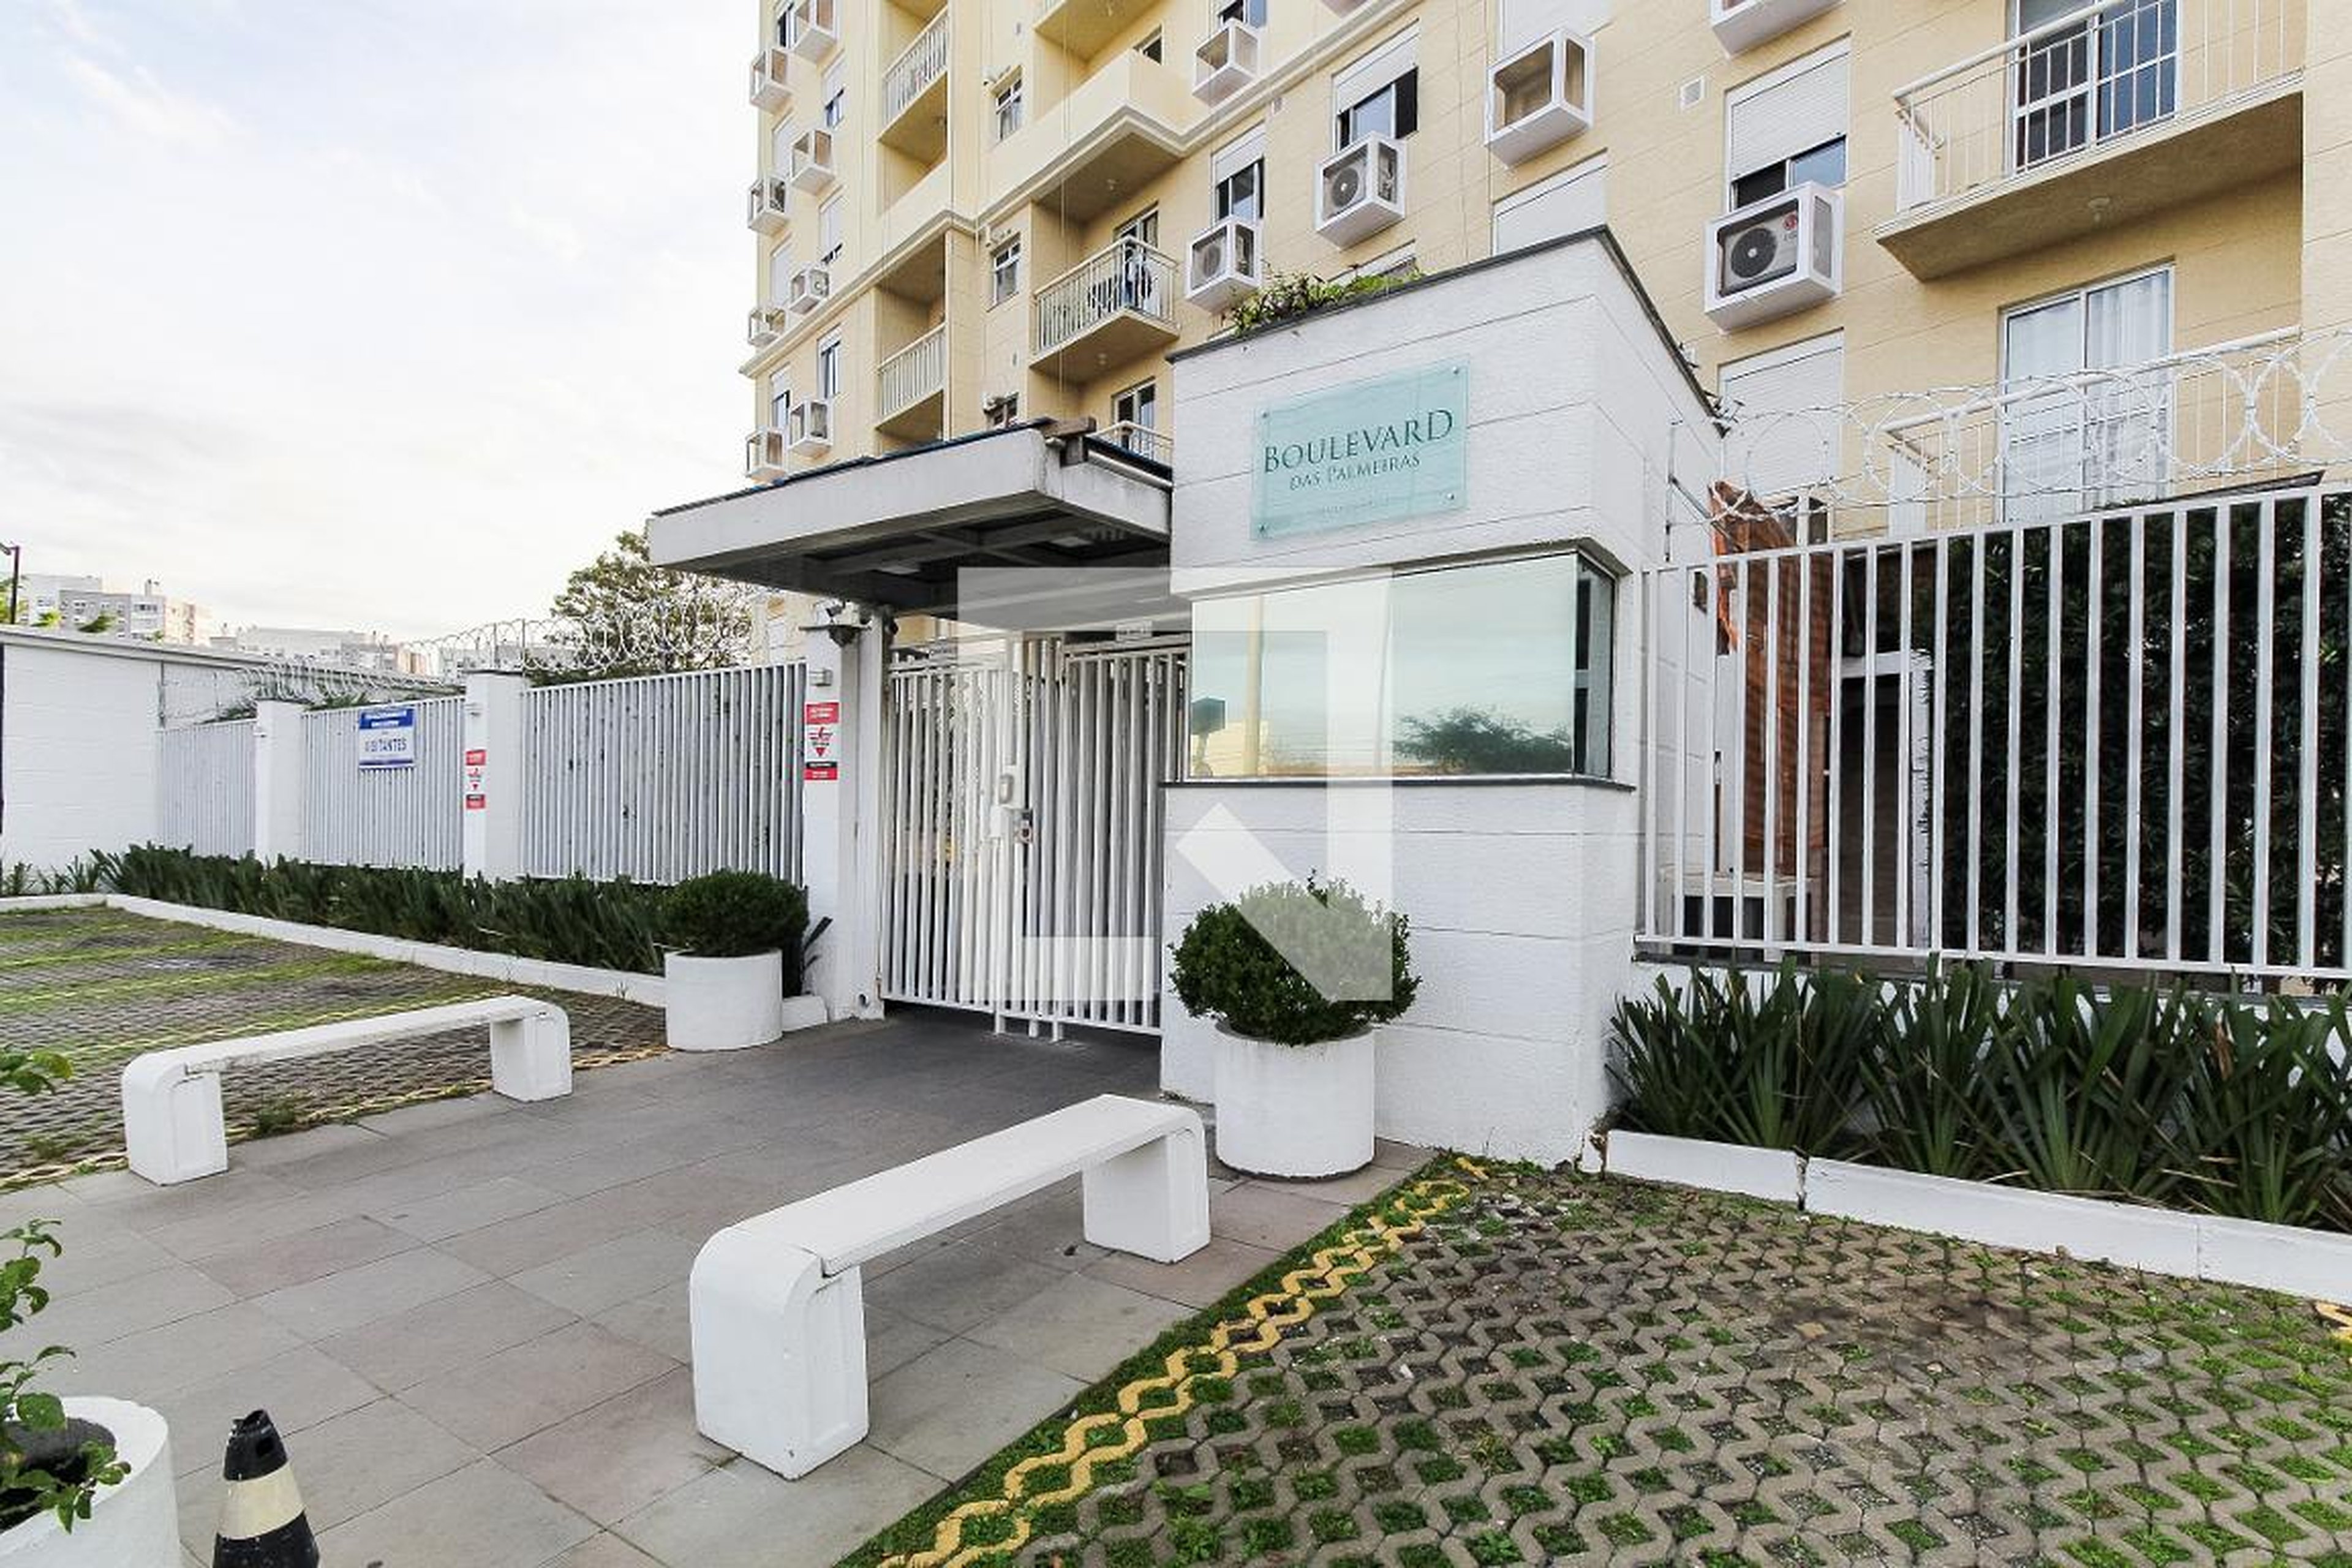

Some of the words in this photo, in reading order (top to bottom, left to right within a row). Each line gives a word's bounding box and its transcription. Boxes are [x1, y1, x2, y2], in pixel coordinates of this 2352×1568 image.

[1264, 409, 1453, 473] BOULEVARD
[1290, 470, 1320, 491] DAS
[1329, 454, 1420, 483] PALMEIRAS
